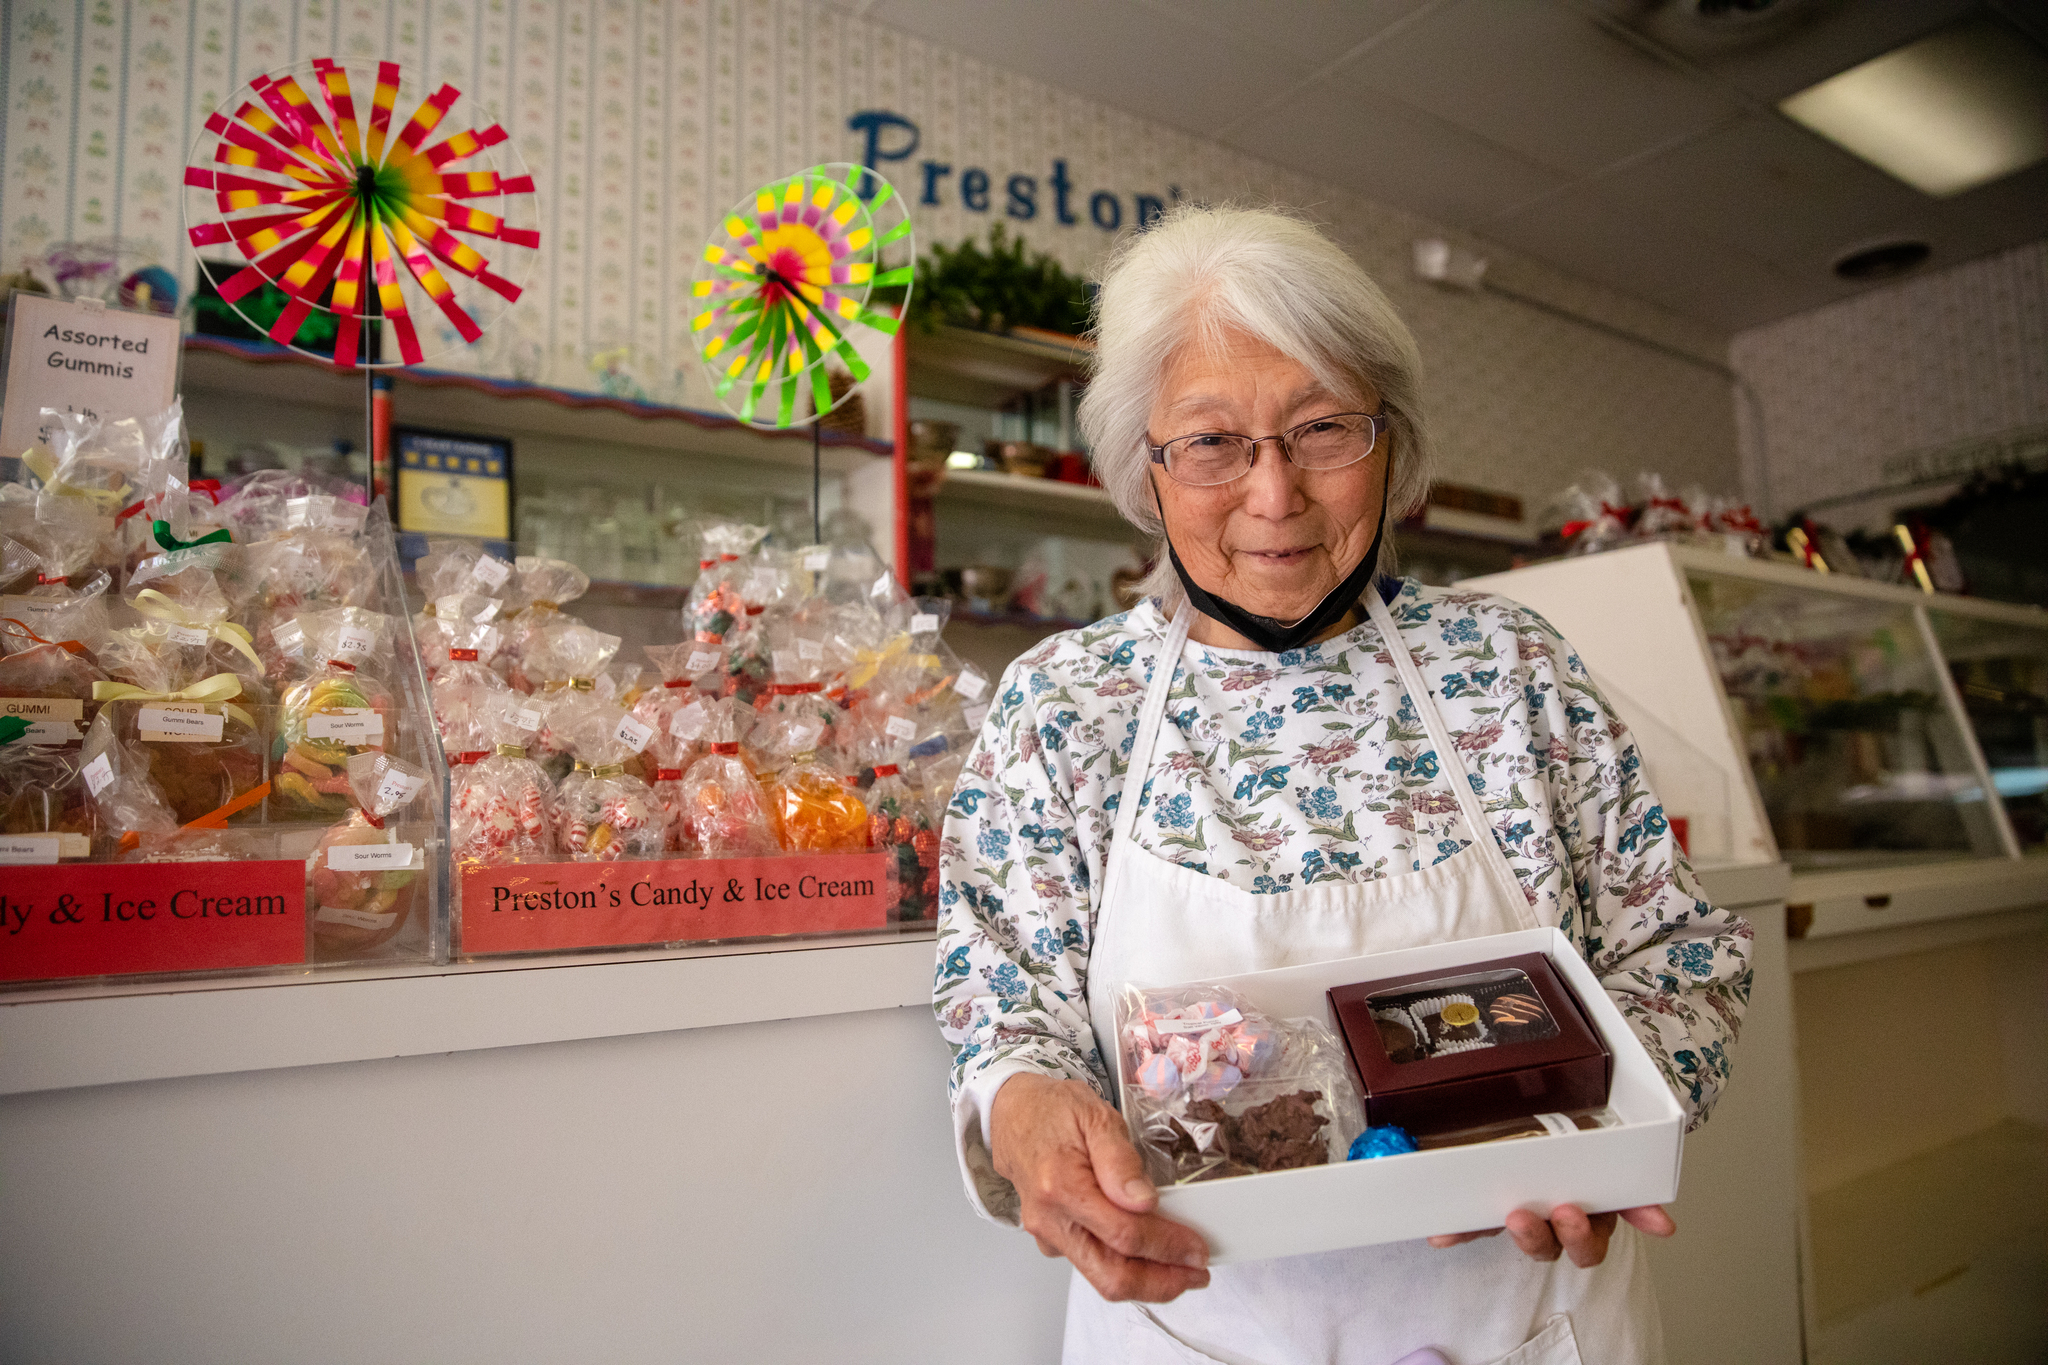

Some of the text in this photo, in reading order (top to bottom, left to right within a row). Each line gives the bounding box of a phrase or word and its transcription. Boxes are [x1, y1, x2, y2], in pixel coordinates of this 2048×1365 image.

[847, 110, 1208, 232] Preston'
[43, 323, 149, 354] Assorted
[47, 350, 134, 379] Gummis
[341, 640, 367, 652] $2.95
[6, 703, 51, 715] GUMMI
[162, 716, 204, 726] Gummi Bears
[384, 786, 407, 800] 2.95
[48, 893, 86, 925] &
[102, 892, 156, 922] Ice
[170, 889, 286, 919] Cream
[491, 875, 874, 912] Preston's Candy & Ice Cream
